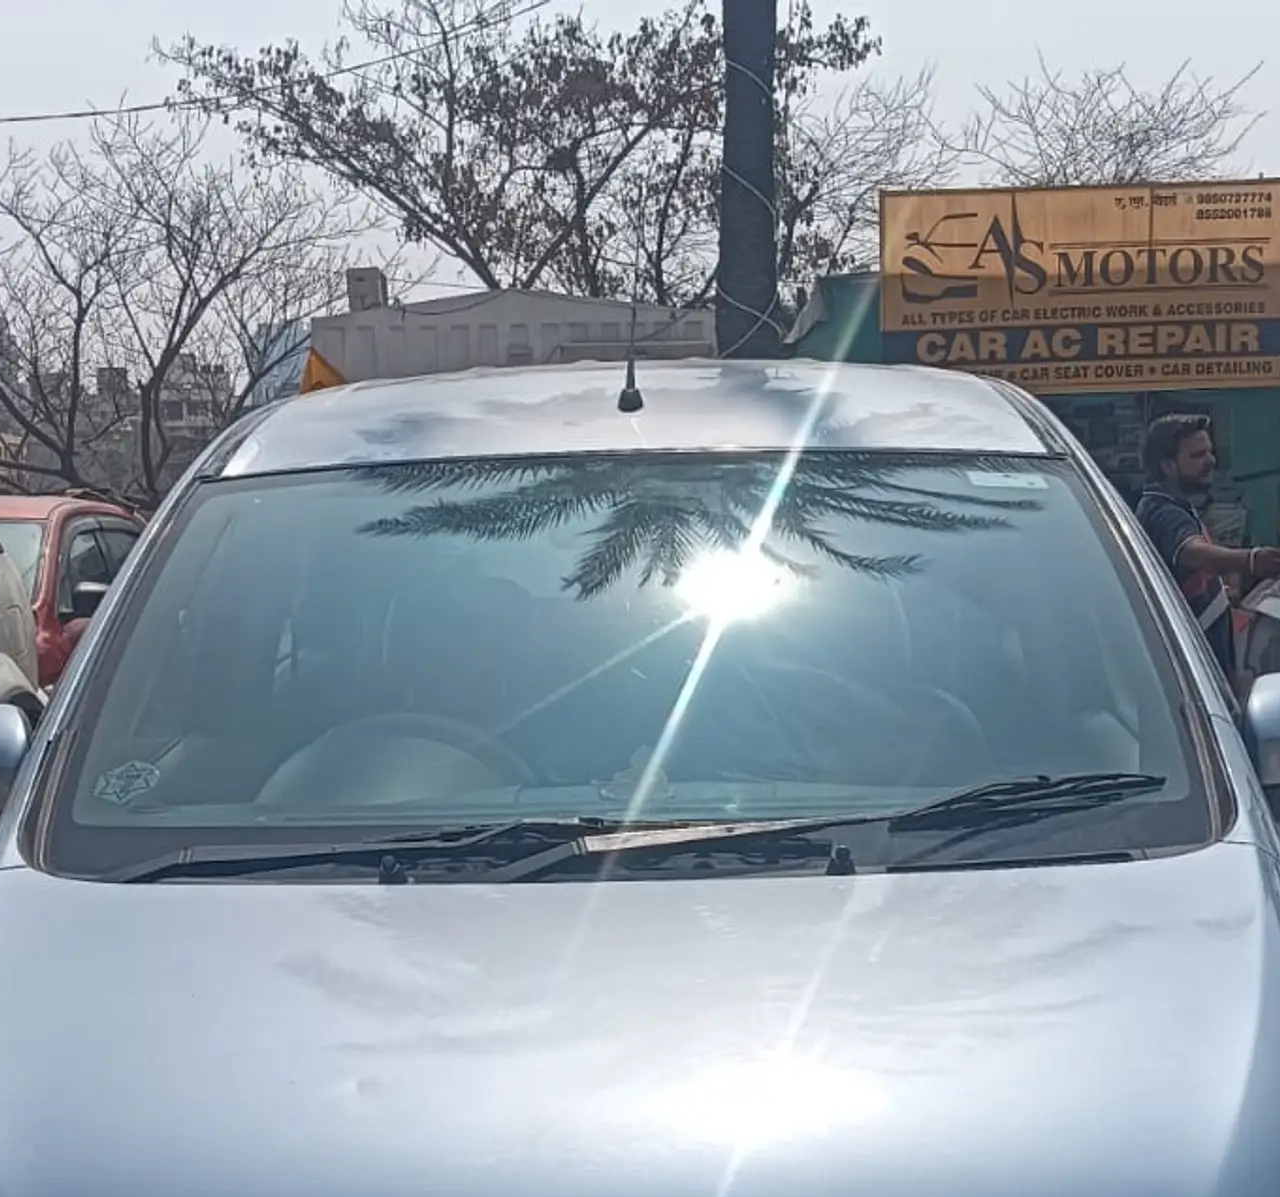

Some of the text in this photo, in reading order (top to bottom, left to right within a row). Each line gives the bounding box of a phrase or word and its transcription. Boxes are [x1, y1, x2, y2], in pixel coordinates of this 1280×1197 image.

[1054, 245, 1265, 287] MOTORS
[902, 301, 1265, 326] ALL TYPES OF CAR ELECTRIC WORK & ACCESSORIES
[916, 323, 1260, 363] CAR AC REPAIR
[1021, 367, 1049, 382] CAR
[1054, 364, 1088, 380] SEAT
[1094, 364, 1144, 378] COVER
[1161, 362, 1190, 376] CAR
[1196, 361, 1272, 376] DETAILING
